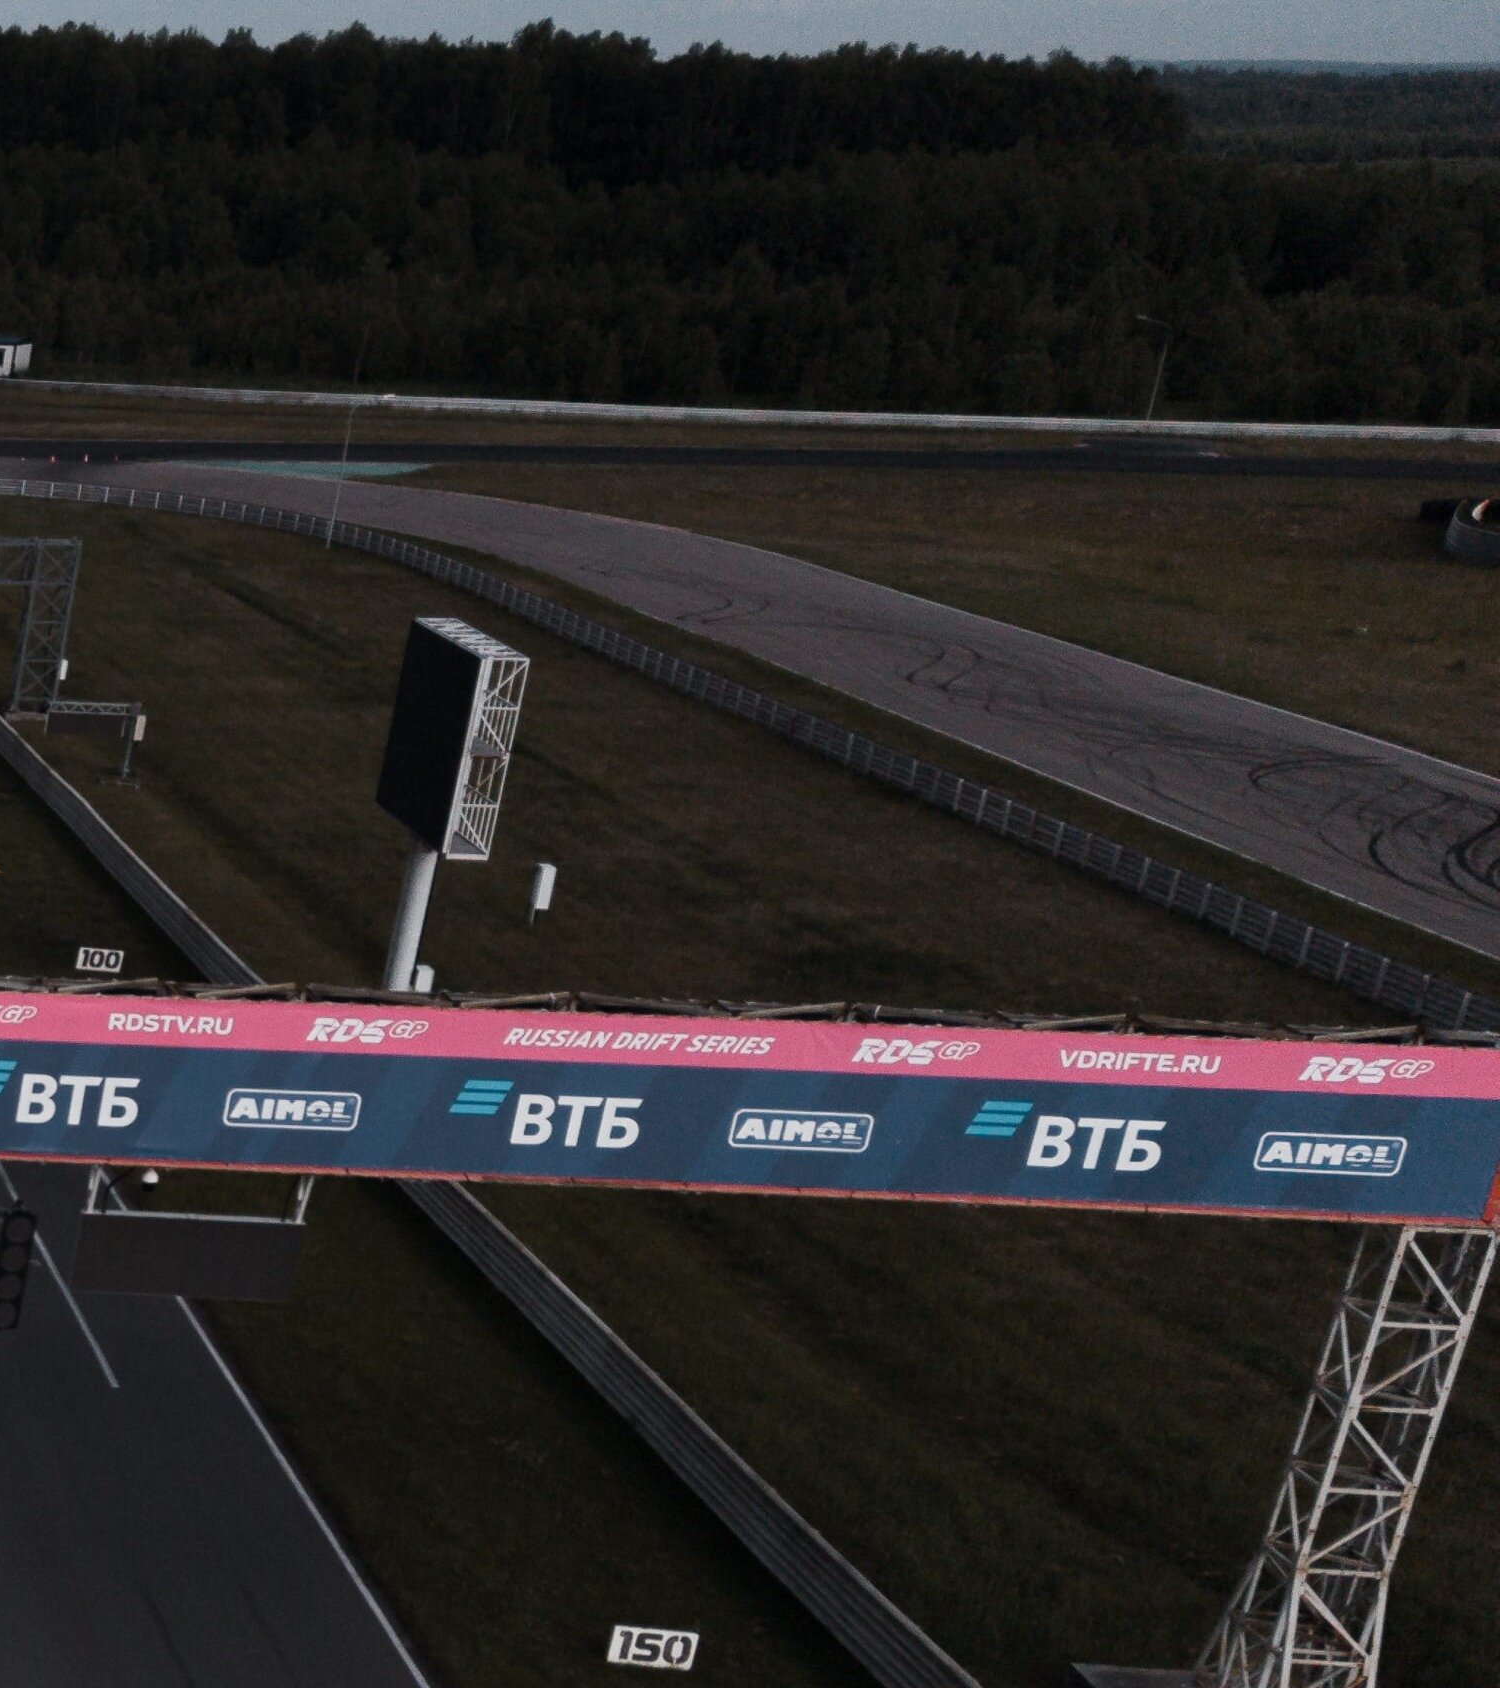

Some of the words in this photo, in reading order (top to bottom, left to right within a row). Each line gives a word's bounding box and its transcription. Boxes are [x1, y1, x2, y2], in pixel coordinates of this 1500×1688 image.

[79, 950, 121, 971] 100
[107, 1013, 234, 1036] RDSTV.RU
[305, 1016, 388, 1044] RDS
[503, 1027, 612, 1049] RUSSIAN
[611, 1032, 688, 1053] DRIFT
[686, 1034, 776, 1055] SERIES
[851, 1037, 938, 1065] RDS
[1059, 1049, 1222, 1075] VDRIFTE.RU
[1298, 1056, 1388, 1084] RDS
[16, 1073, 141, 1128] ВТБ
[229, 1097, 353, 1123] AIMOL
[510, 1094, 643, 1149] ВТБ
[735, 1117, 864, 1145] AIMOL
[1026, 1115, 1167, 1172] ВТБ
[1261, 1140, 1398, 1168] AIMOL
[618, 1630, 693, 1664] 150
